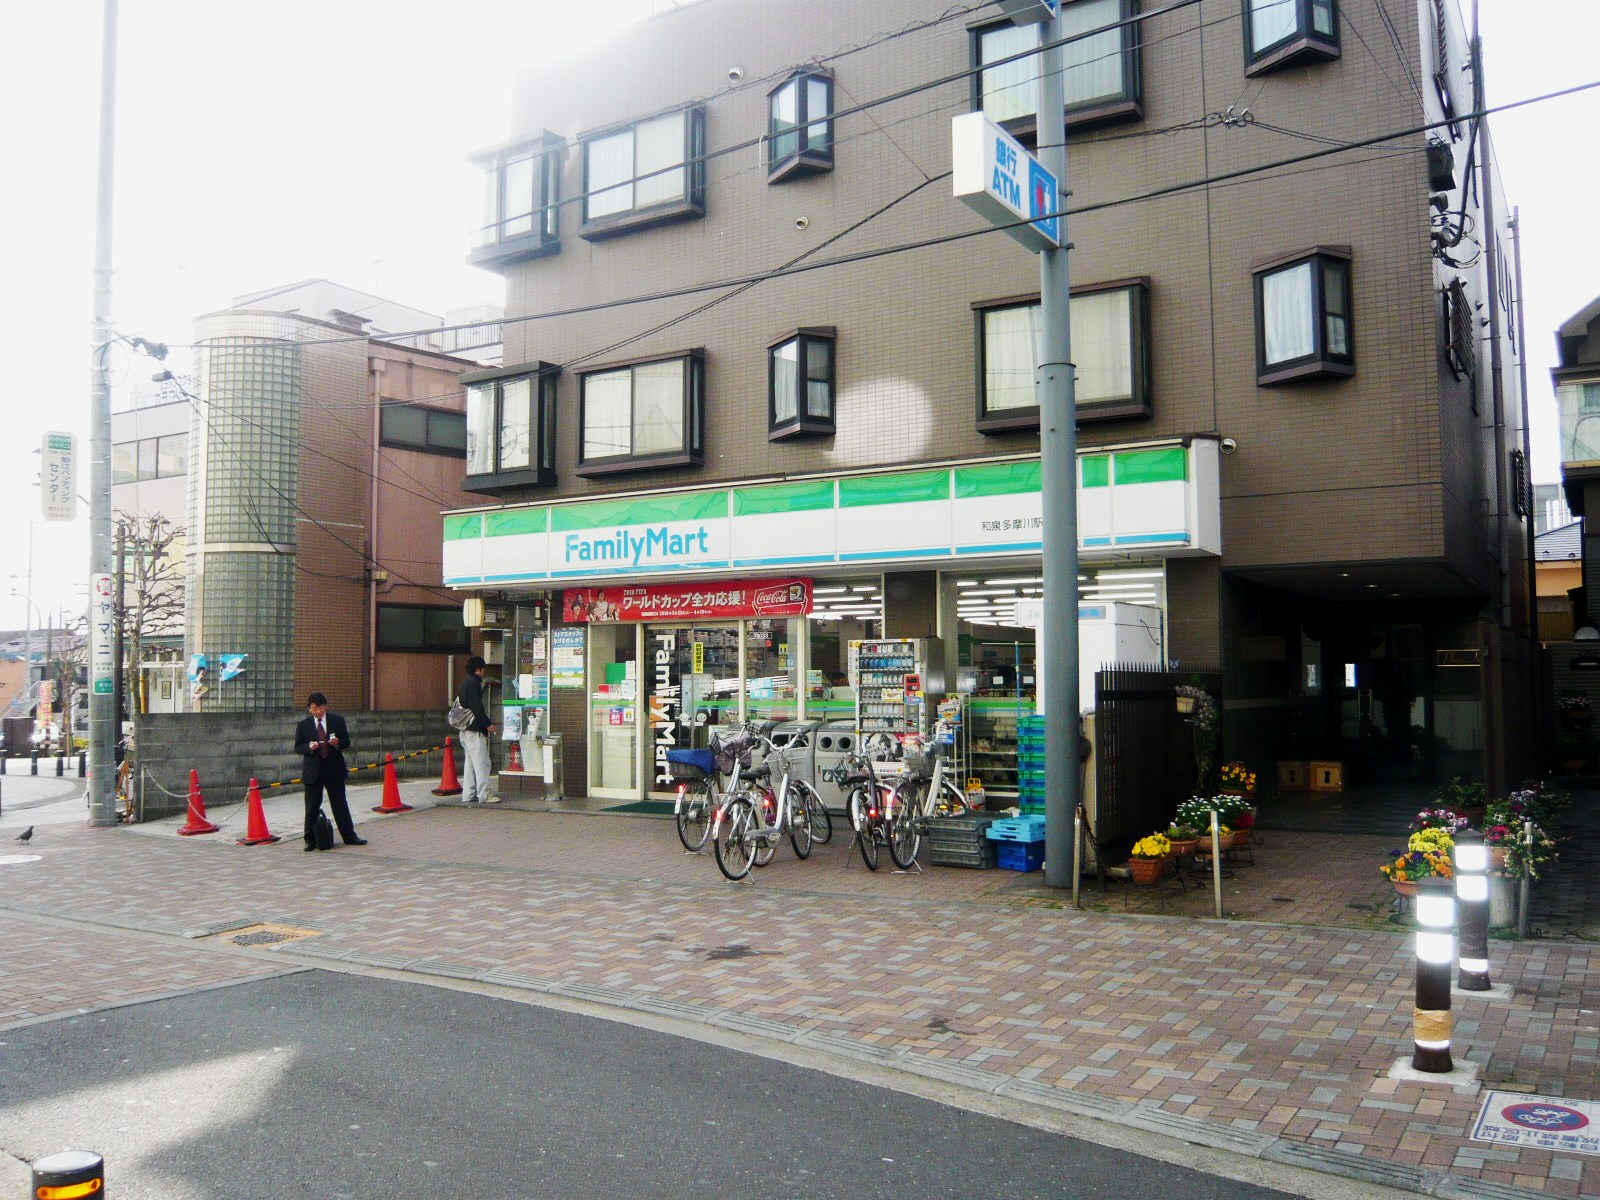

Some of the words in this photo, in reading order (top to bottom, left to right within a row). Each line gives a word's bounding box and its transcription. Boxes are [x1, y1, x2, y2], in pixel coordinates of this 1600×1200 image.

[995, 137, 1017, 177] 銀行
[992, 165, 1021, 210] ATM
[48, 463, 59, 502] センター
[565, 525, 708, 566] FamilyMart
[622, 589, 746, 611] ワールドカップ全力応援！
[650, 634, 676, 785] FamilyMart
